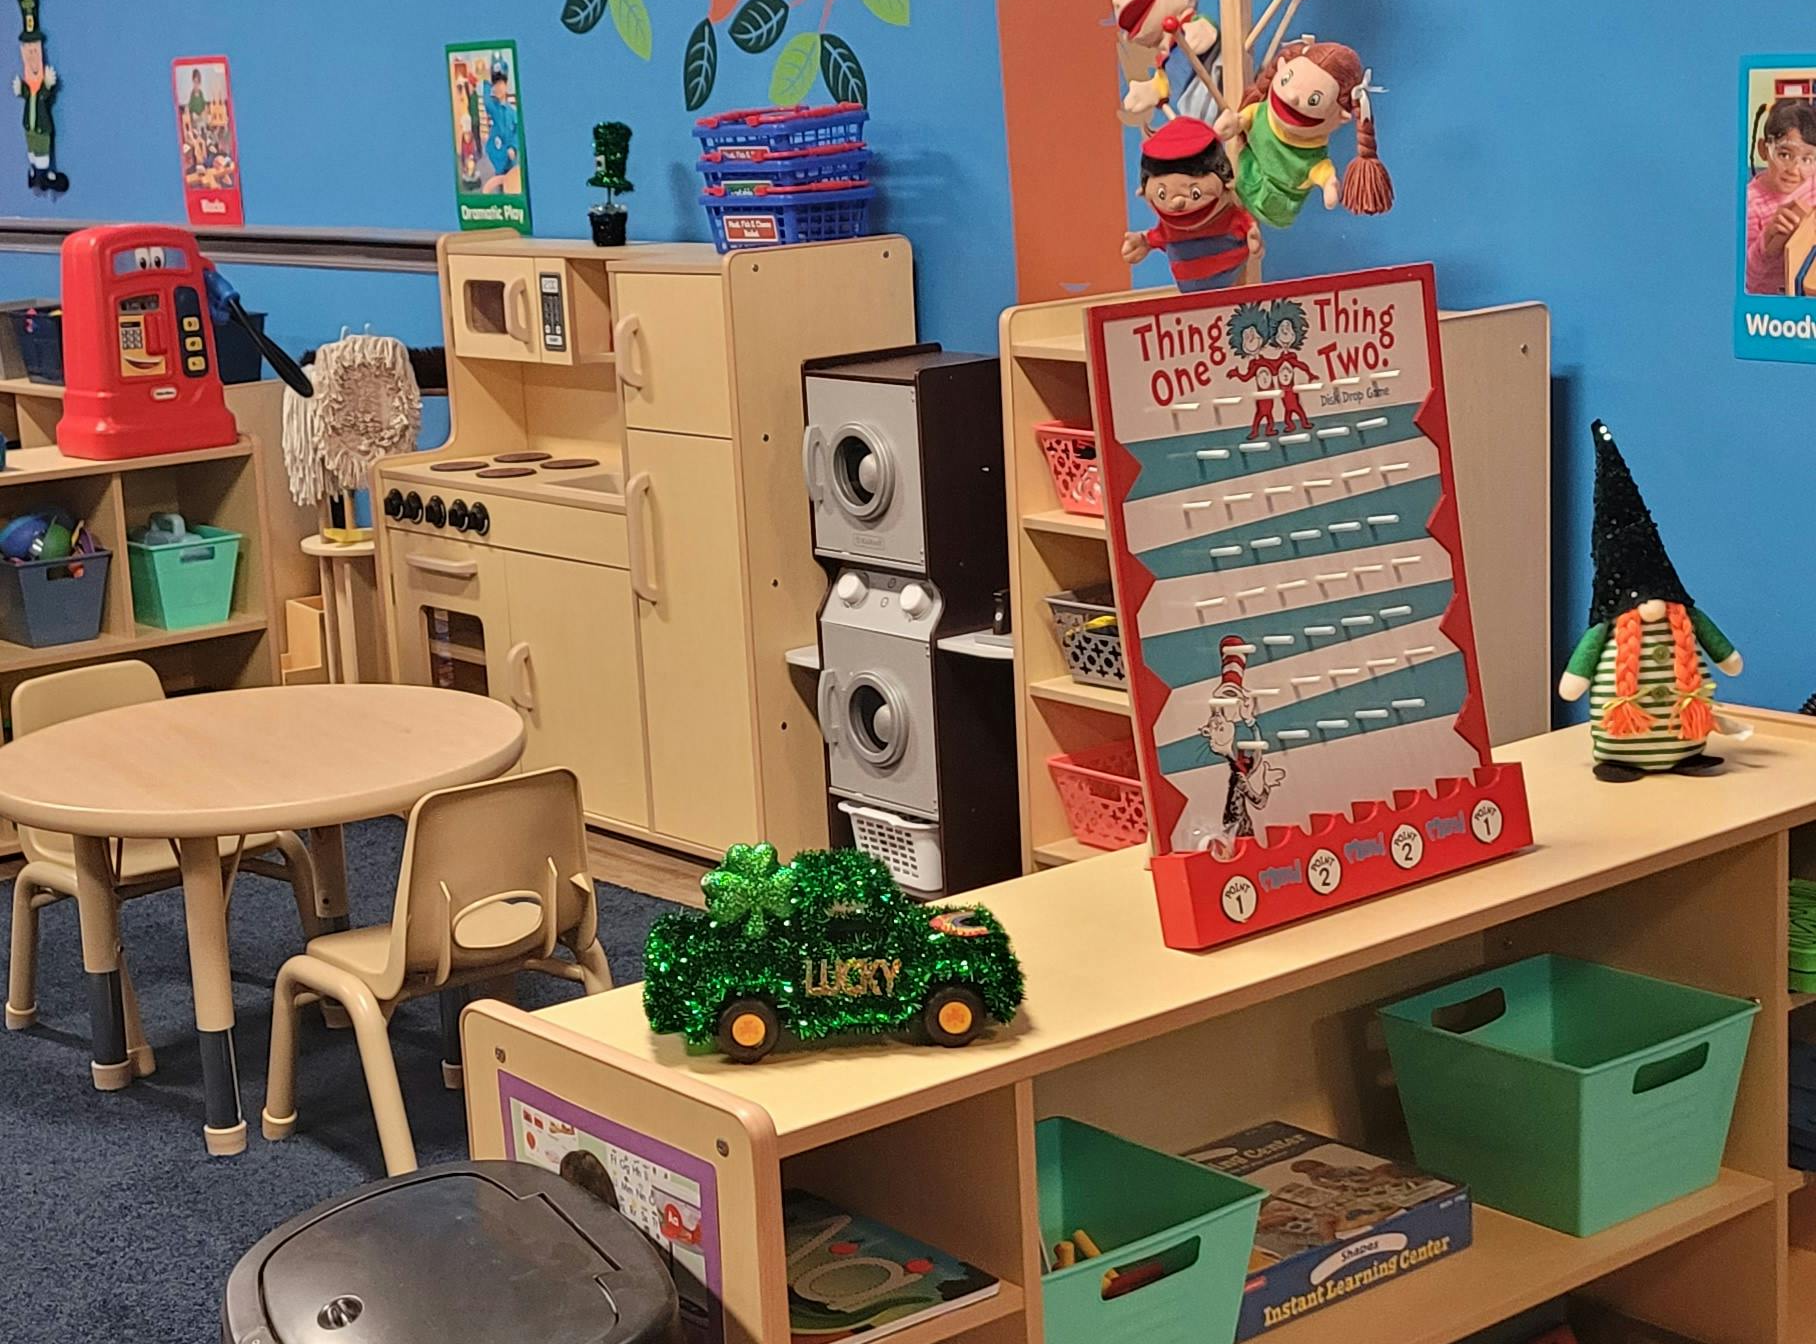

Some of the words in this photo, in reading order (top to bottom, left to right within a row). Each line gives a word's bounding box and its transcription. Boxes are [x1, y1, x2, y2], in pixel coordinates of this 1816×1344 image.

[503, 204, 524, 224] Play
[1133, 314, 1227, 367] Thing
[1314, 290, 1396, 350] Thing
[1151, 360, 1211, 406] One
[1317, 342, 1389, 383] Two.
[1342, 391, 1364, 405] Drop
[1475, 806, 1497, 821] POINT
[1483, 817, 1492, 836] 1
[1394, 832, 1418, 846] POINT
[1402, 842, 1413, 861] 2
[1310, 856, 1336, 872] POINT
[1319, 867, 1331, 887] 2
[1225, 883, 1251, 900] POINT
[1236, 894, 1244, 915] 1
[805, 958, 902, 997] LUCKY
[1341, 1239, 1379, 1262] Shapes
[1263, 1287, 1325, 1328] Instant
[1325, 1255, 1399, 1299] Learning
[1399, 1236, 1451, 1270] Center
